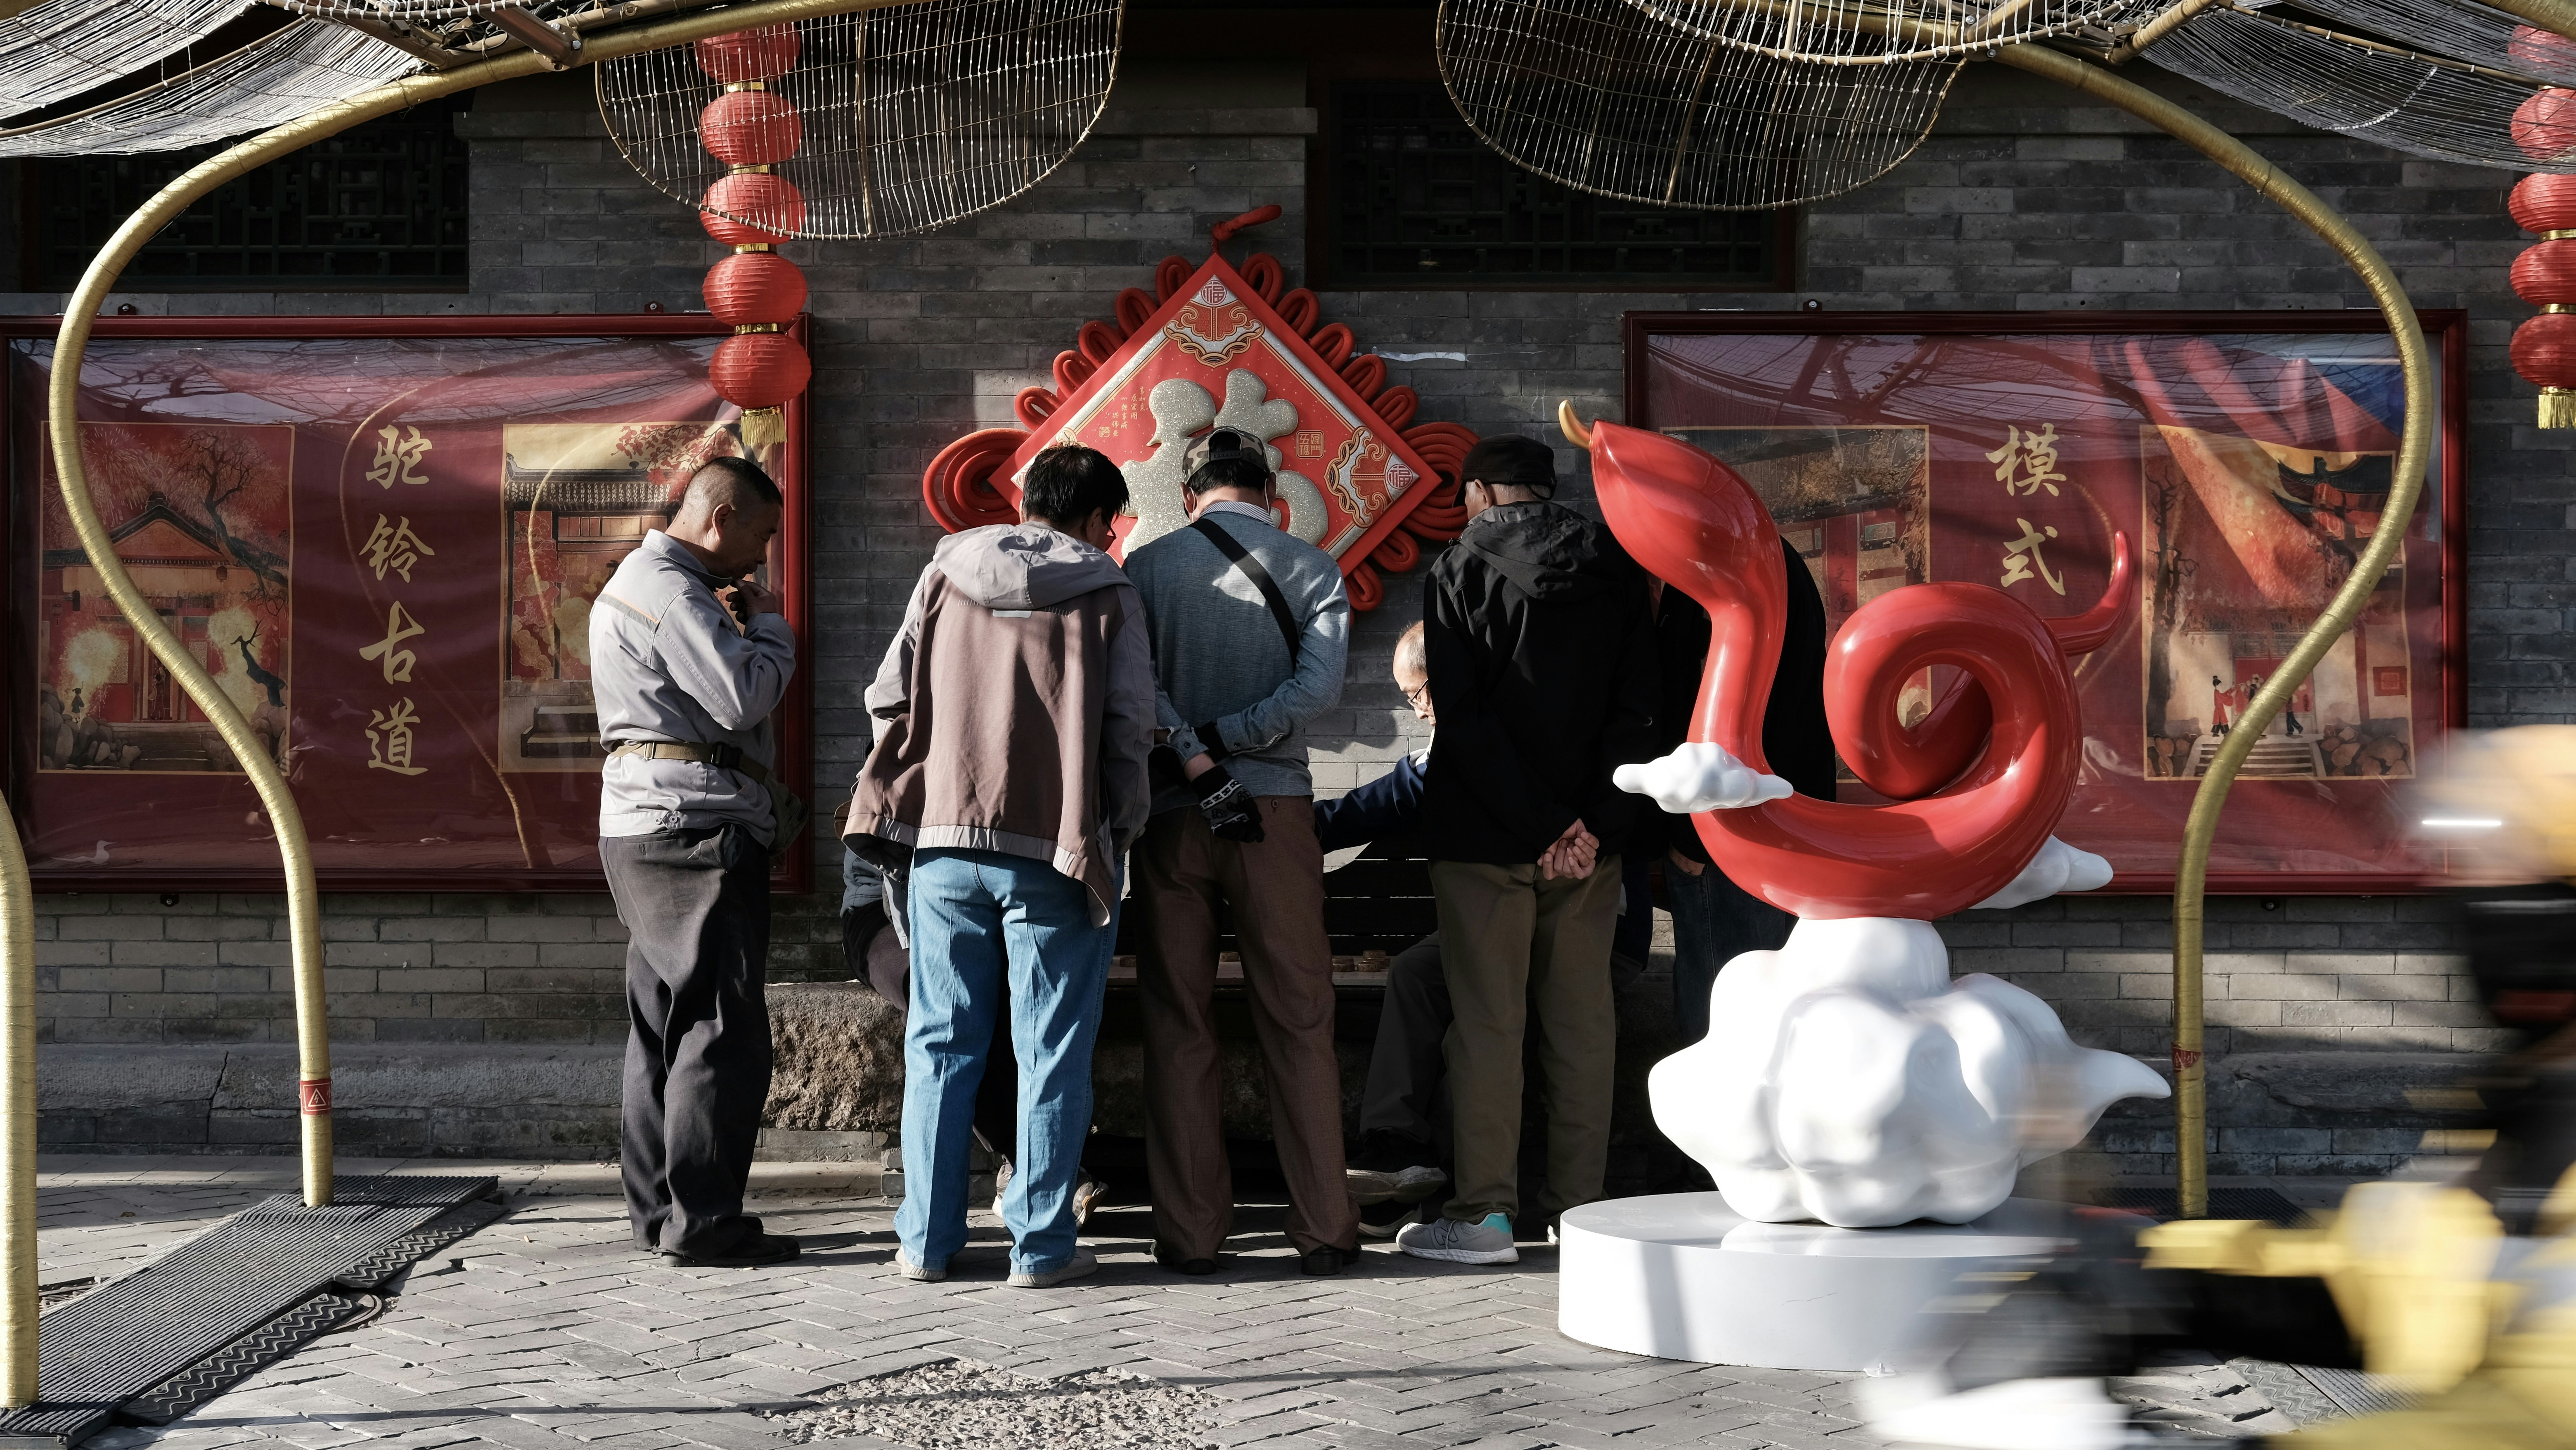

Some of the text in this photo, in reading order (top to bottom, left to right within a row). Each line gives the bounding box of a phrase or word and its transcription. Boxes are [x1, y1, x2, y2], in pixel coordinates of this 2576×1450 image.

[1202, 280, 1226, 305] 福
[1387, 464, 1413, 489] 福
[1986, 422, 2067, 596] 模式
[359, 424, 435, 776] 驼铃古道
